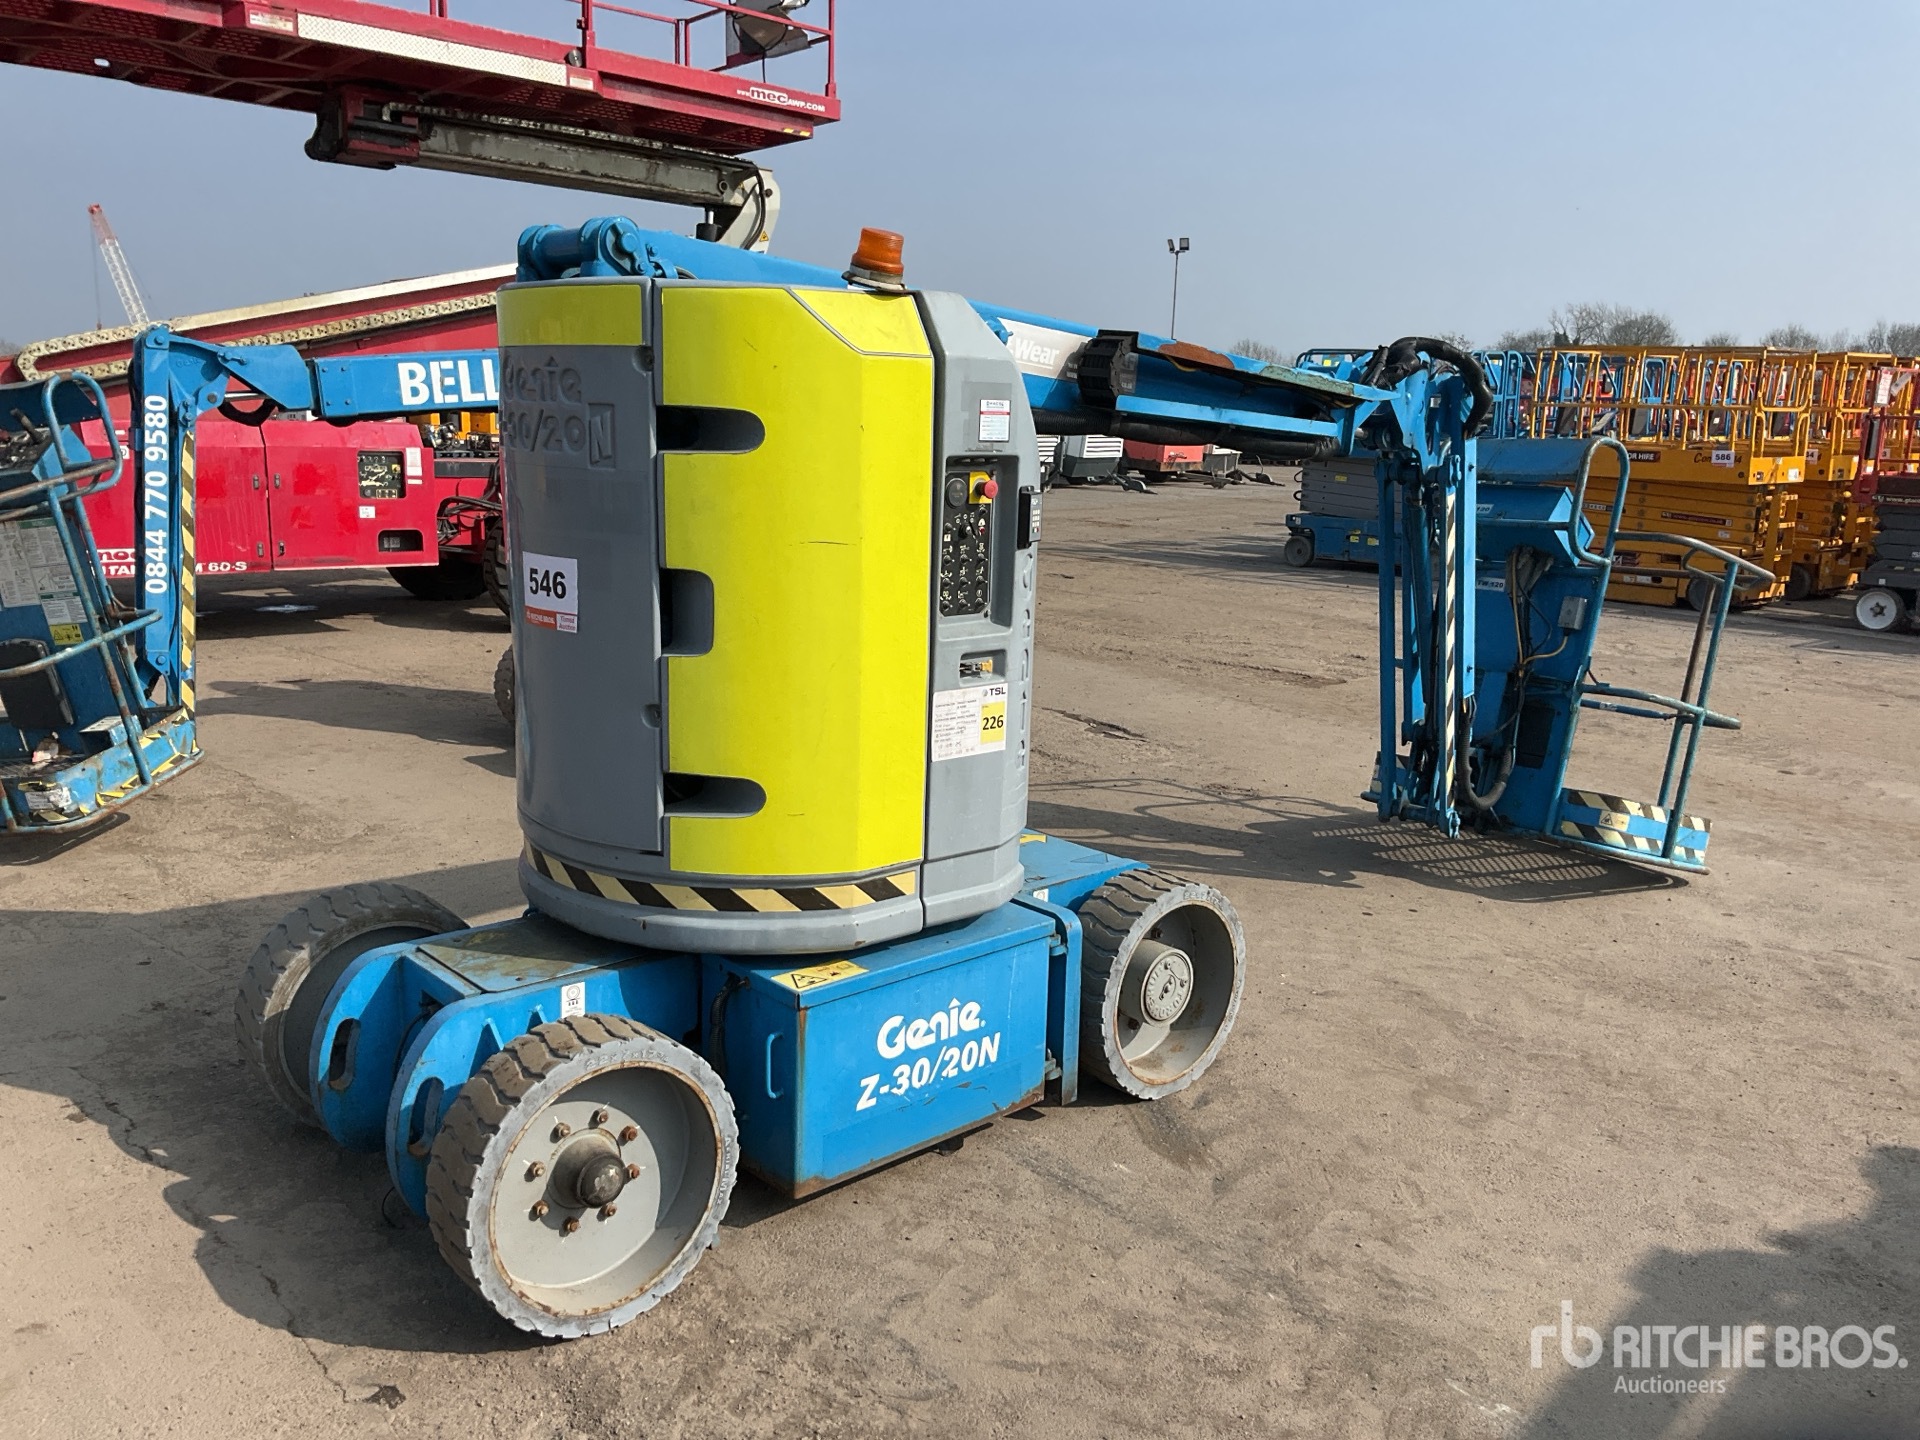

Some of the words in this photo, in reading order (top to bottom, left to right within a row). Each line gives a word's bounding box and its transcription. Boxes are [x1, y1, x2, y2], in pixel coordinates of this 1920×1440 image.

[1015, 340, 1060, 365] Wear
[145, 395, 168, 461] 9580
[1627, 452, 1638, 460] OR
[1638, 452, 1655, 460] HIRE
[1715, 453, 1731, 461] 586
[145, 471, 168, 519] 770
[145, 529, 168, 594] 0844
[529, 567, 567, 600] 546
[989, 686, 1006, 696] TSL
[982, 715, 1004, 731] 226
[856, 1032, 1001, 1112] Z-30/20N
